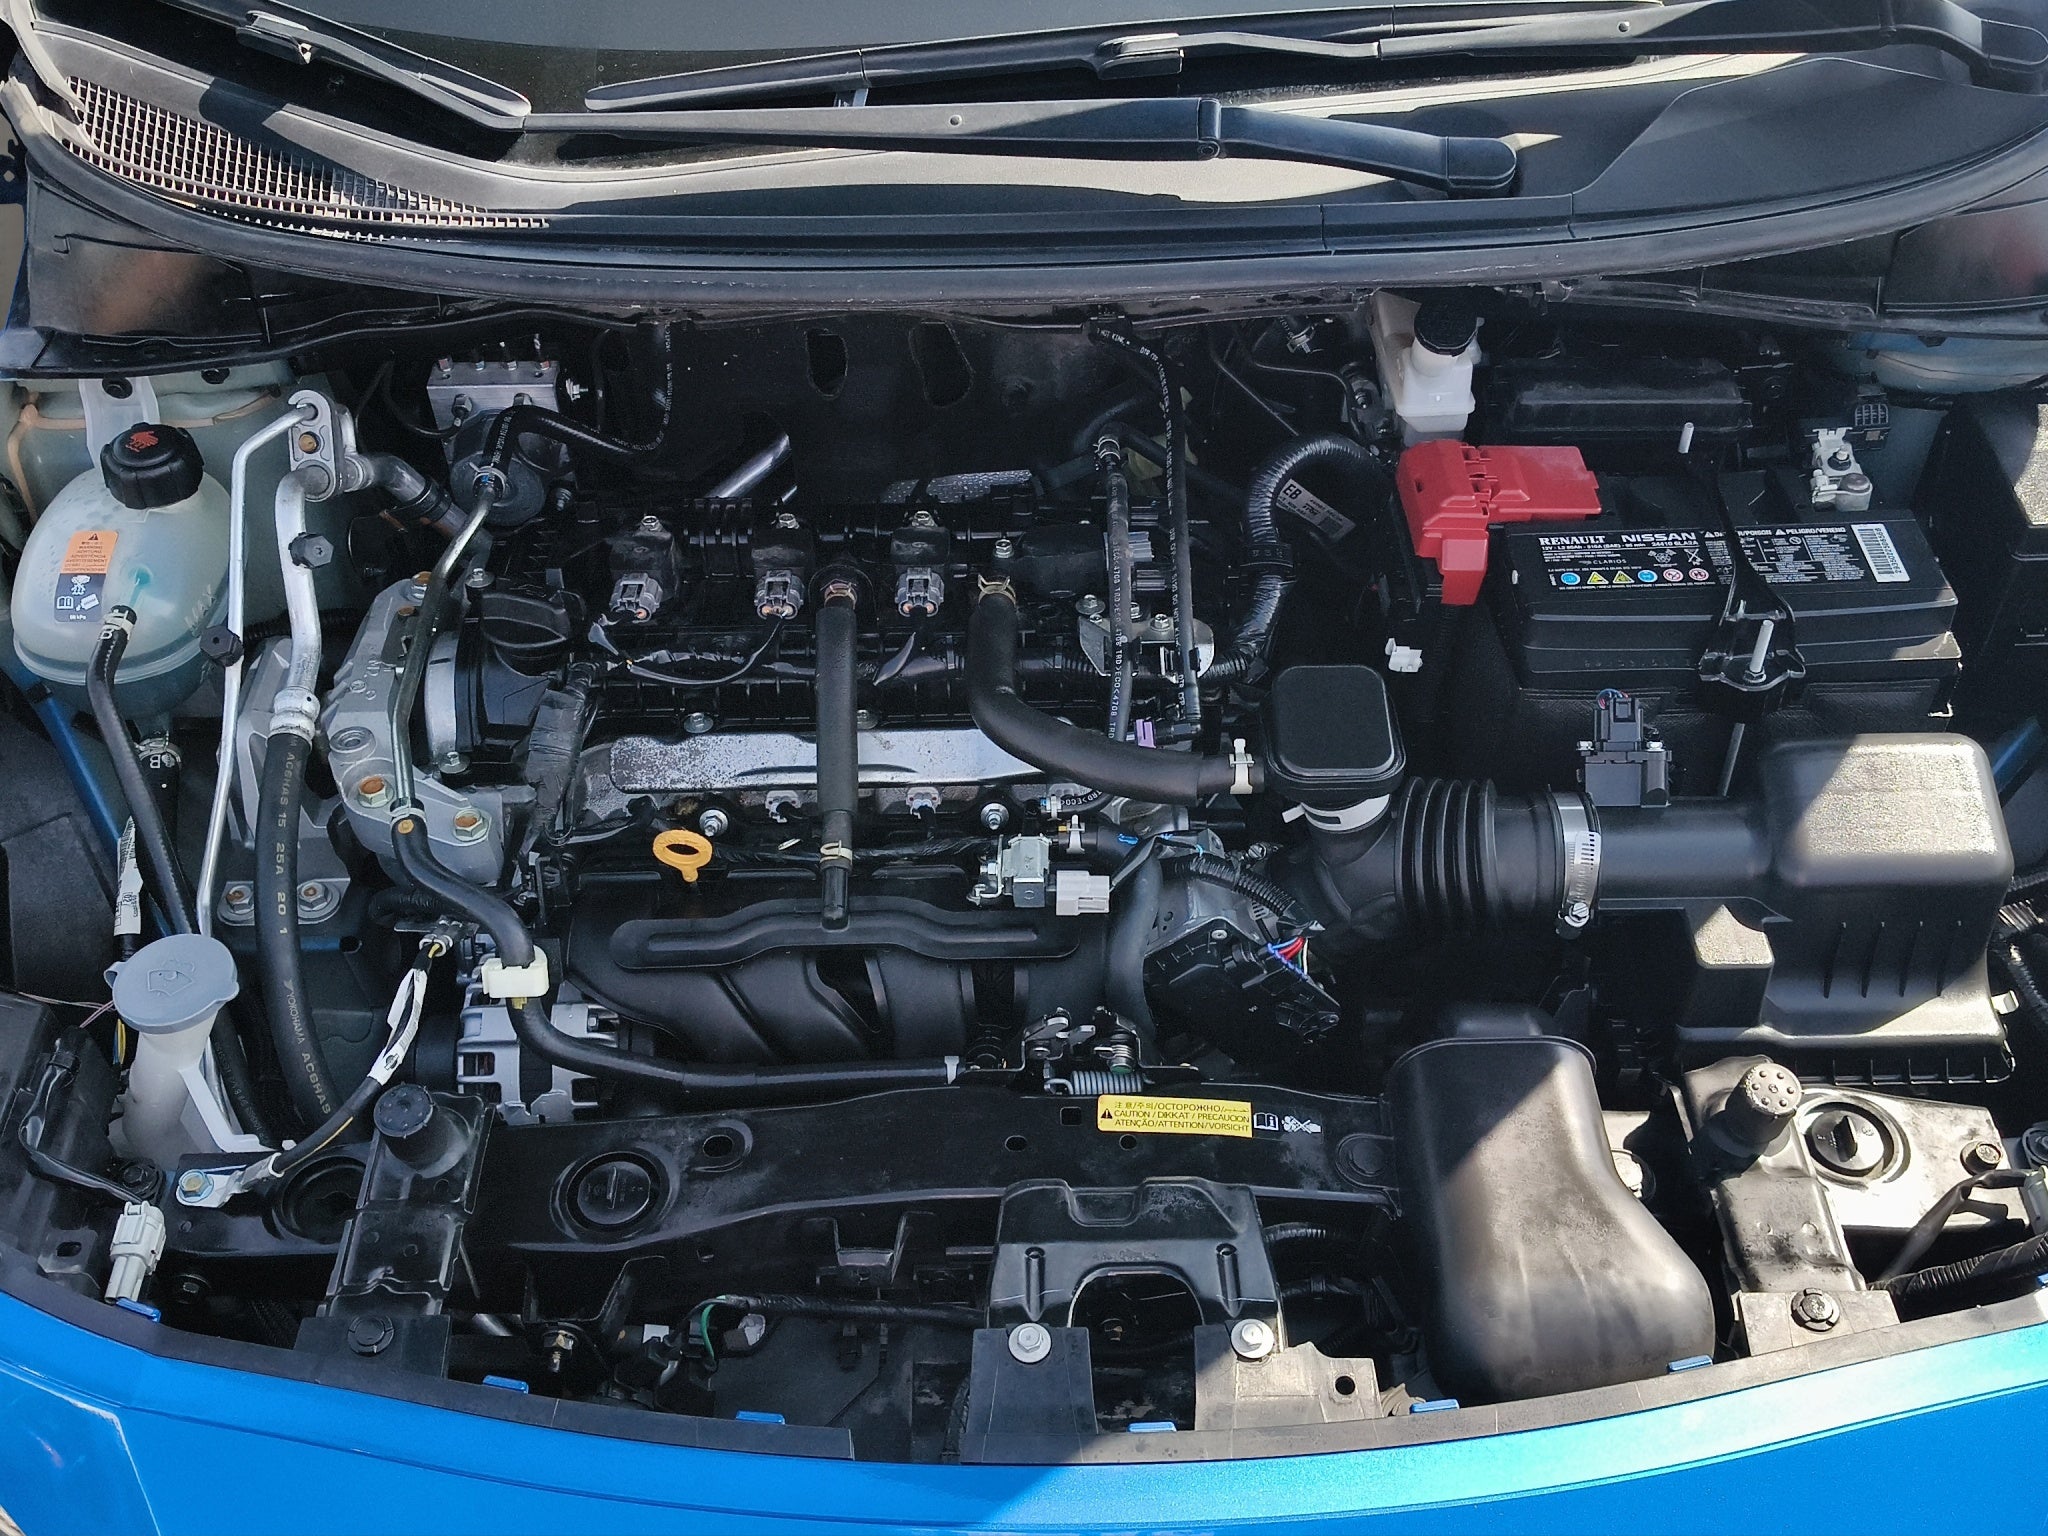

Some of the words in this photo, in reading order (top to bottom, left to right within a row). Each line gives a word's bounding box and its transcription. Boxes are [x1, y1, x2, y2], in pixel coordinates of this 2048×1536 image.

[1282, 483, 1302, 500] EB
[1538, 535, 1606, 546] RENAULT
[1621, 532, 1697, 543] NISSAN
[277, 812, 287, 828] 15
[275, 843, 285, 875] 25A
[277, 892, 287, 916] 20
[286, 991, 305, 1045] YOKOHAMA
[1114, 1109, 1150, 1118] CAUTION
[1157, 1111, 1190, 1119] DIKKAT
